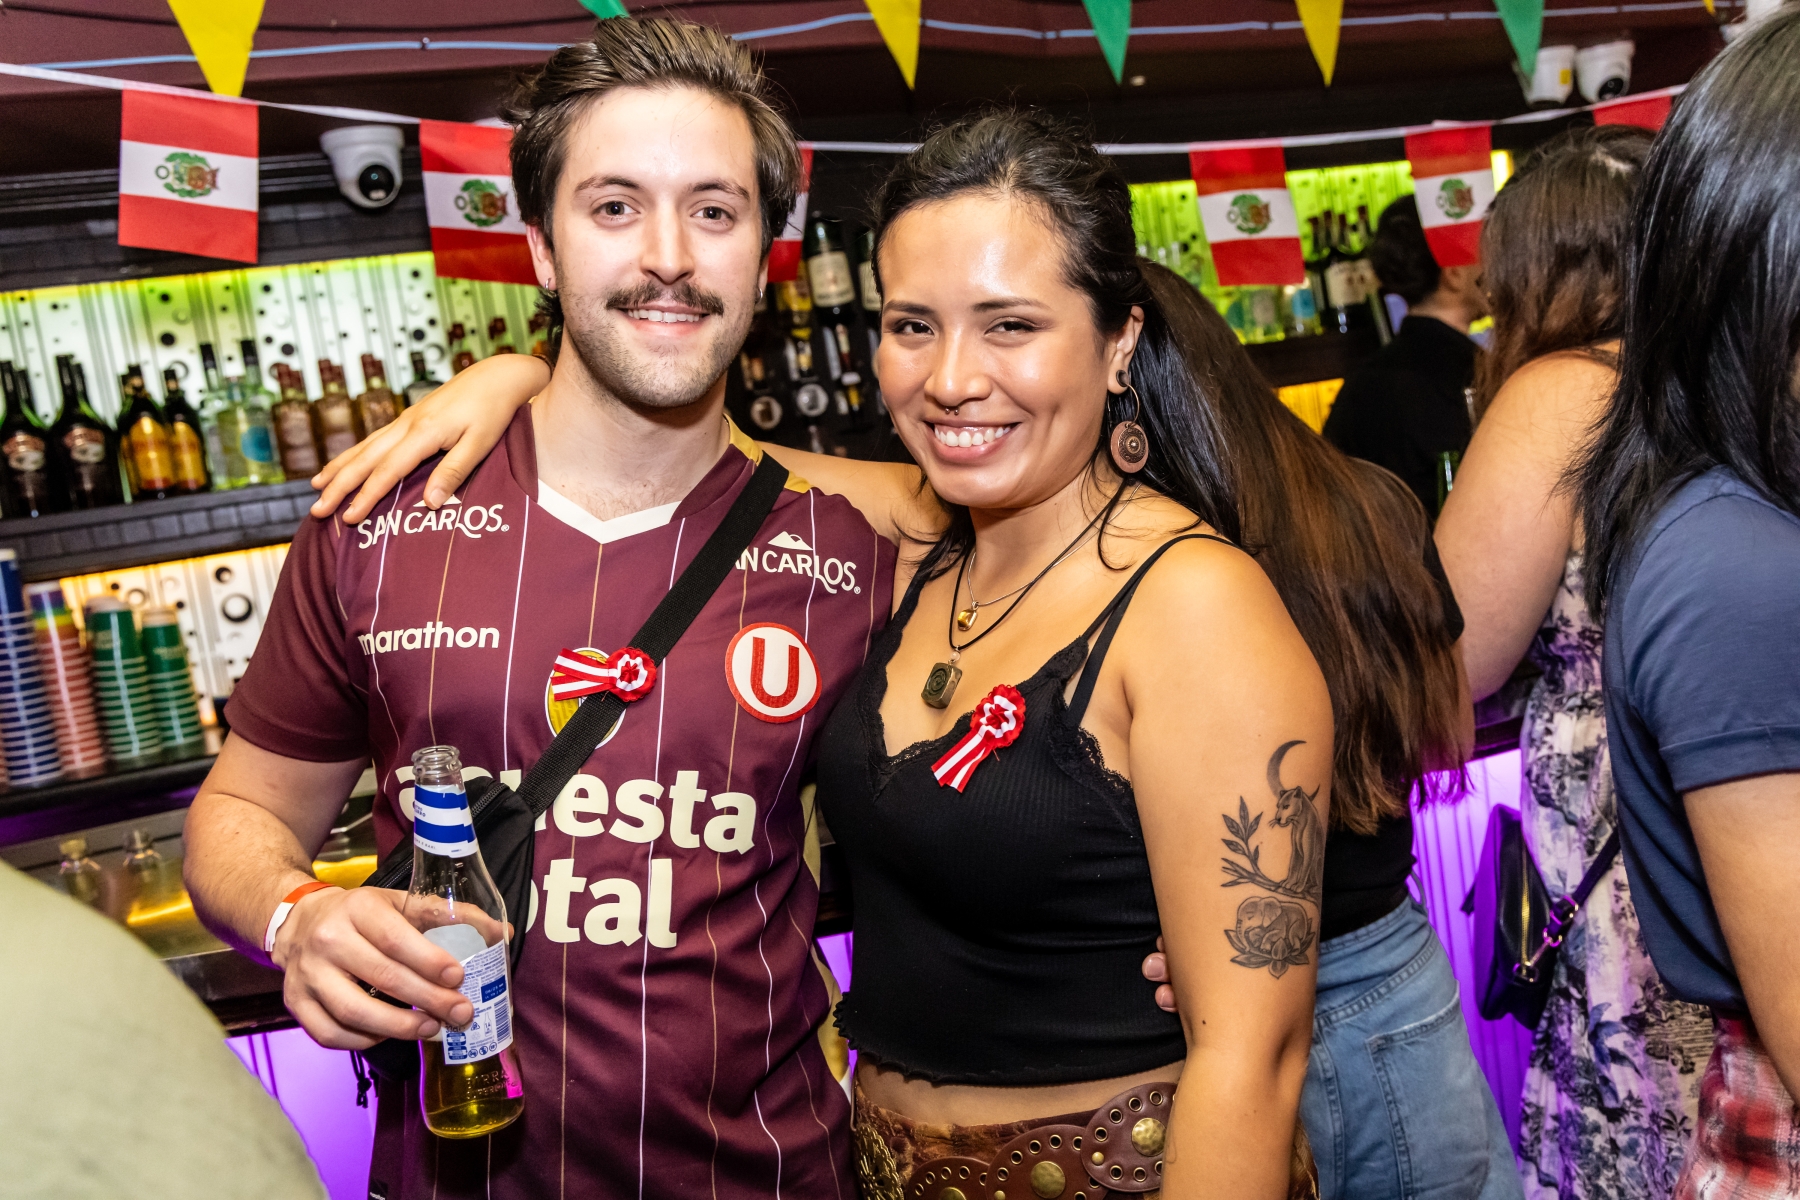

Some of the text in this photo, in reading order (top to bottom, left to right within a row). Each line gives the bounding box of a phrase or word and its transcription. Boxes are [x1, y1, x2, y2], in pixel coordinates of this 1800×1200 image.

[357, 509, 403, 549] SAN
[357, 621, 500, 656] marathon
[750, 636, 799, 709] U
